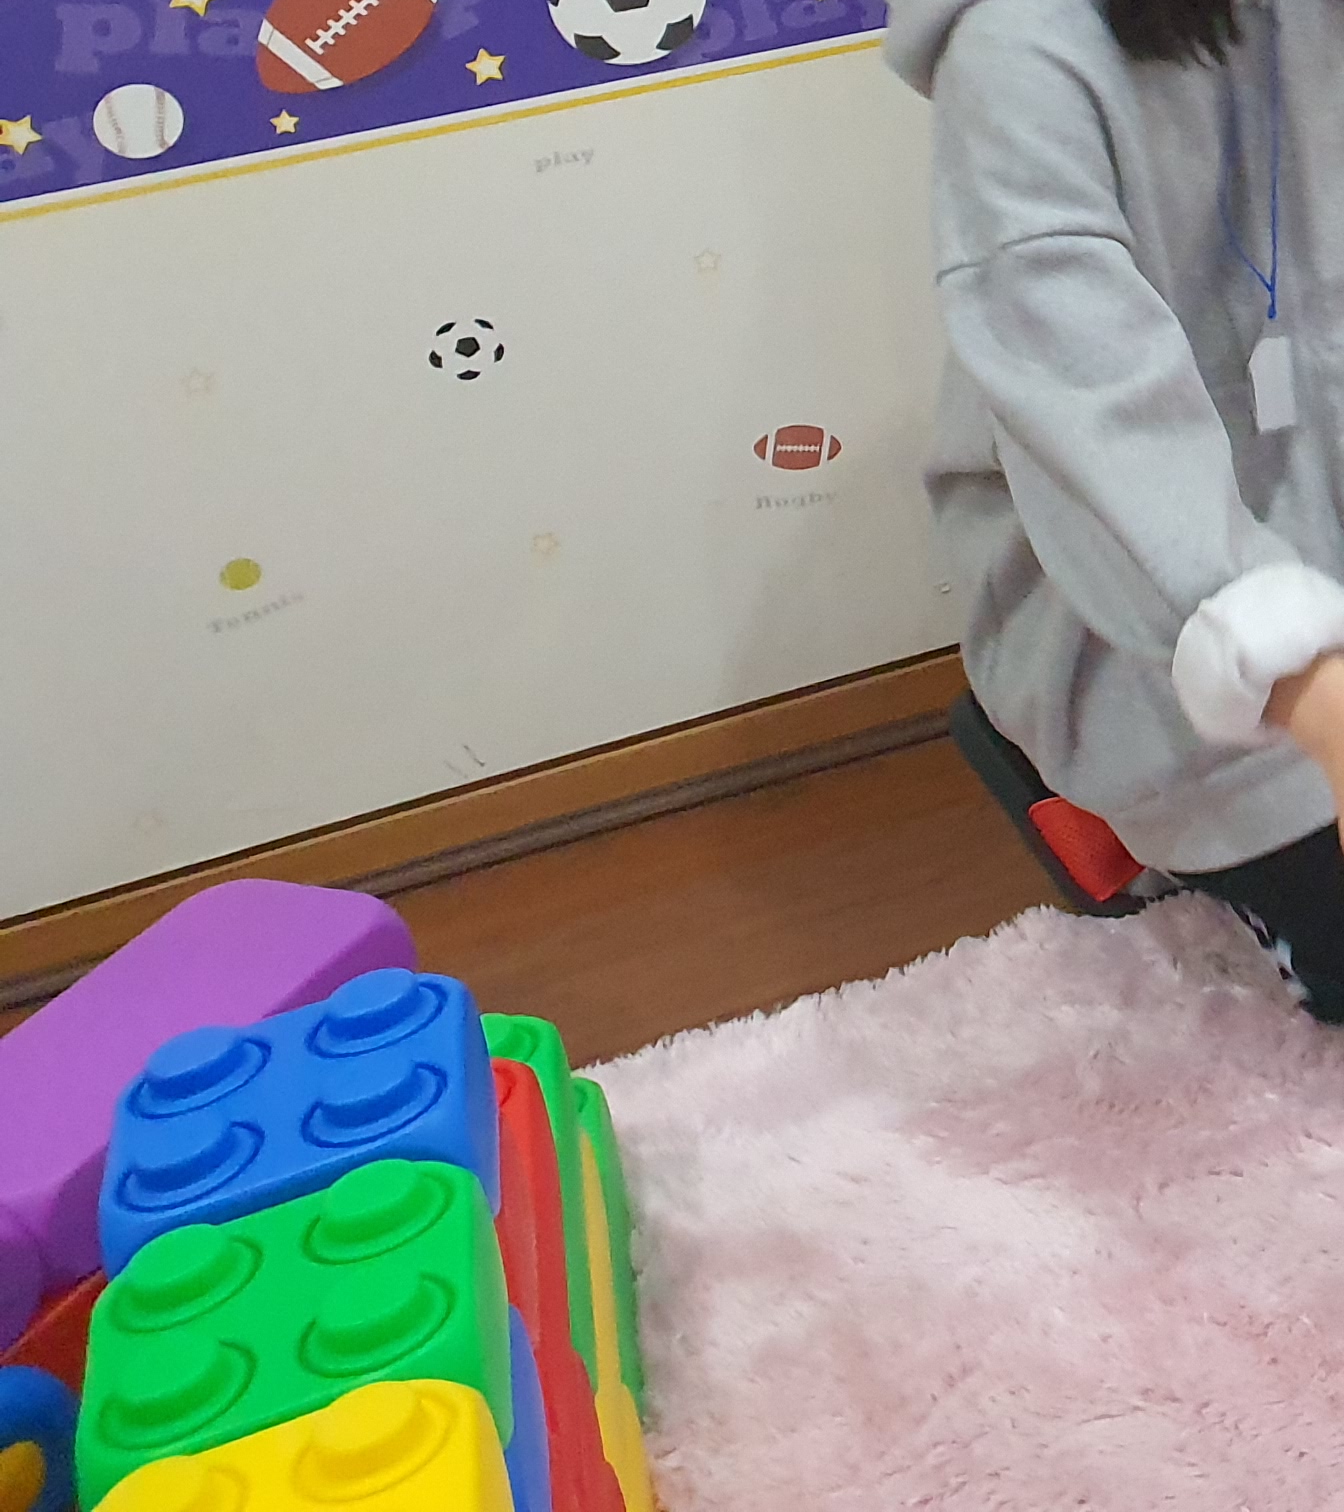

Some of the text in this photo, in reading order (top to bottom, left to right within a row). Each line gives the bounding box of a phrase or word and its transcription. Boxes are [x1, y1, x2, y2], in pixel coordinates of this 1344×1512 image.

[535, 150, 594, 173] play
[756, 492, 838, 510] Rugby
[208, 595, 304, 633] Tennis
